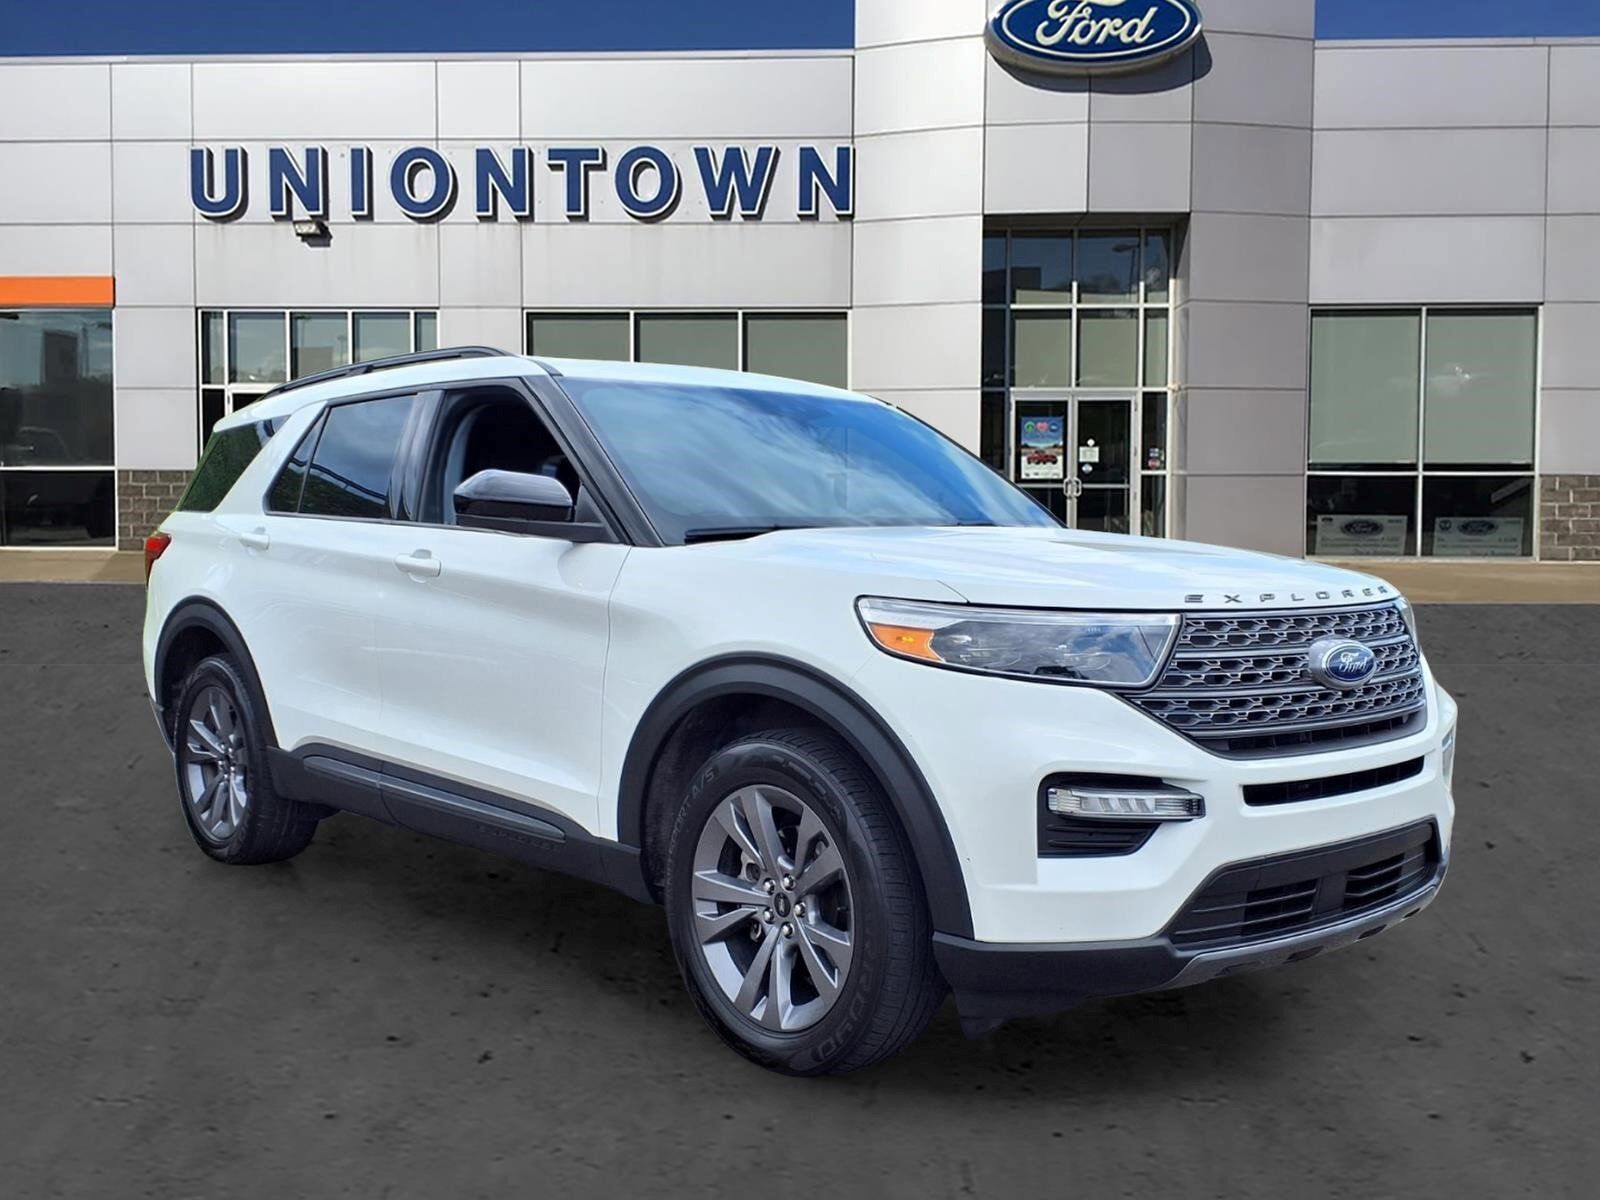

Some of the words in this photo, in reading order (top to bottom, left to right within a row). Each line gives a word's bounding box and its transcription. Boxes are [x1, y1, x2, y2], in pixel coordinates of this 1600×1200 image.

[1035, 0, 1158, 46] Ford
[190, 145, 854, 220] UNIONTOWN
[1184, 585, 1389, 604] EXPLORER
[1339, 651, 1369, 673] Ford
